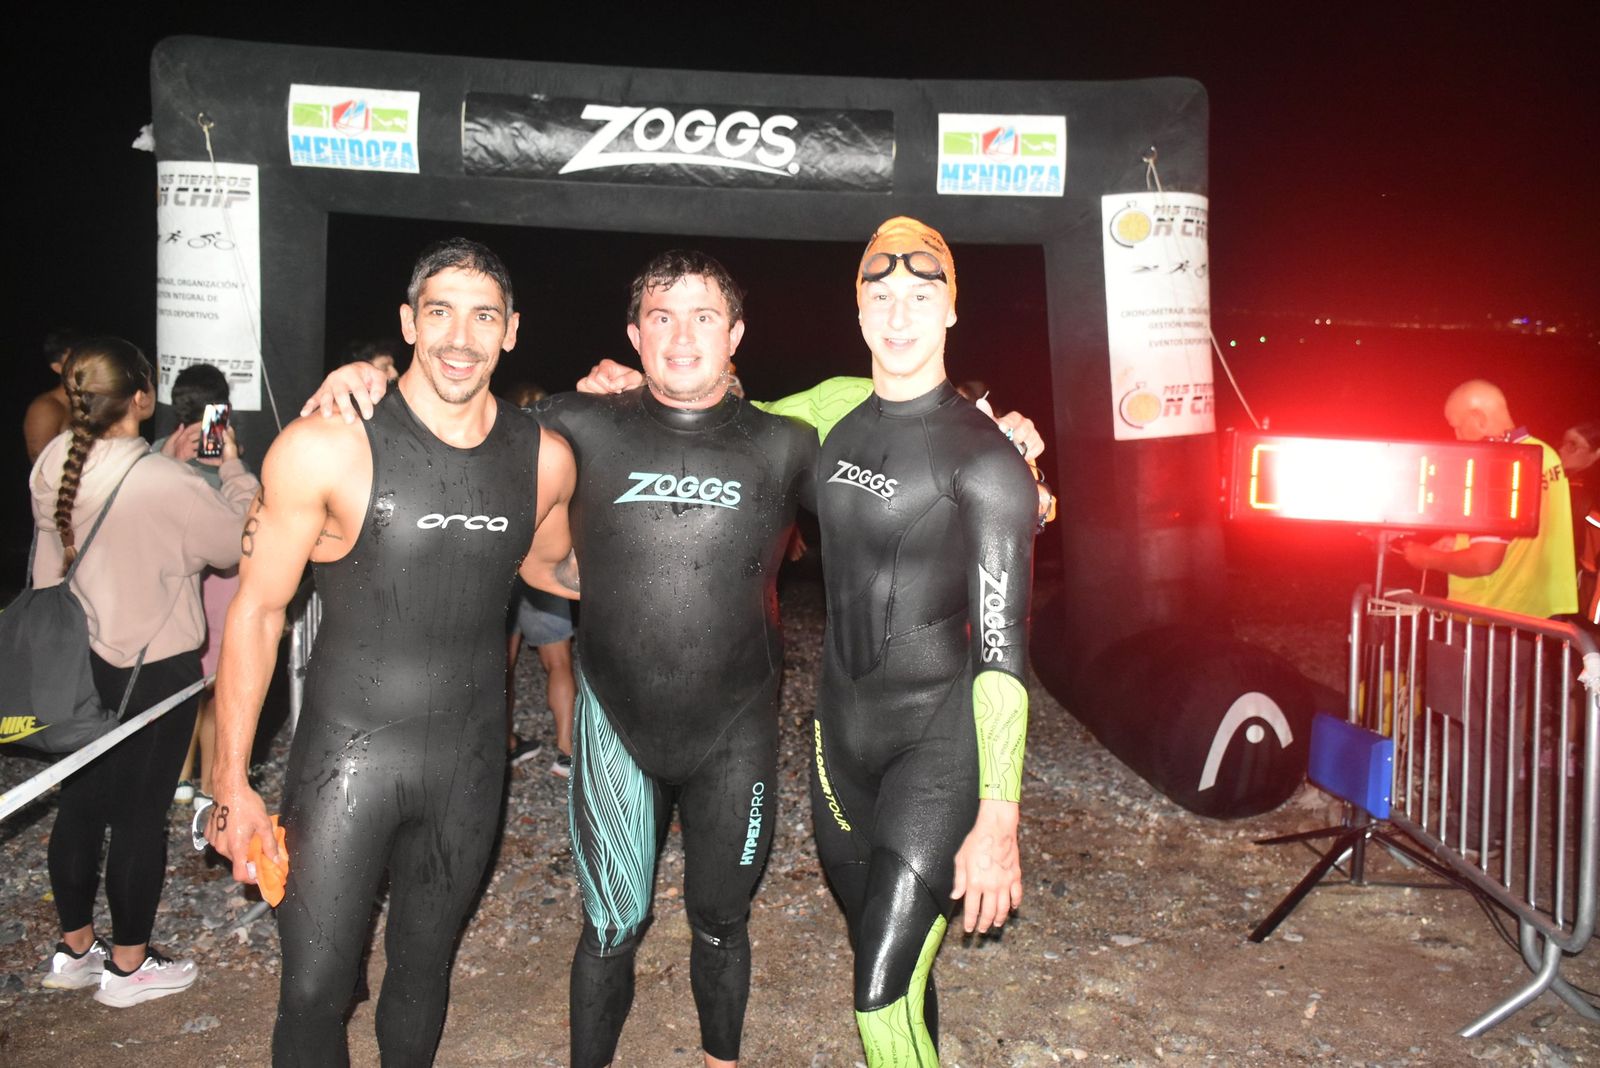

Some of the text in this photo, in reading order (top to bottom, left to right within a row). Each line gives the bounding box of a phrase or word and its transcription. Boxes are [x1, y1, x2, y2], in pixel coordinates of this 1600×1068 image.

[291, 134, 417, 170] MENDOZA
[558, 104, 799, 177] ZOGGS
[178, 174, 252, 188] TIEMPOS
[939, 163, 1061, 193] MENDOZA
[613, 472, 742, 510] ZOGGS
[827, 459, 899, 502] ZOGGS
[417, 512, 509, 532] orca
[978, 563, 1009, 664] ZOGGS
[0, 715, 37, 735] NIKE
